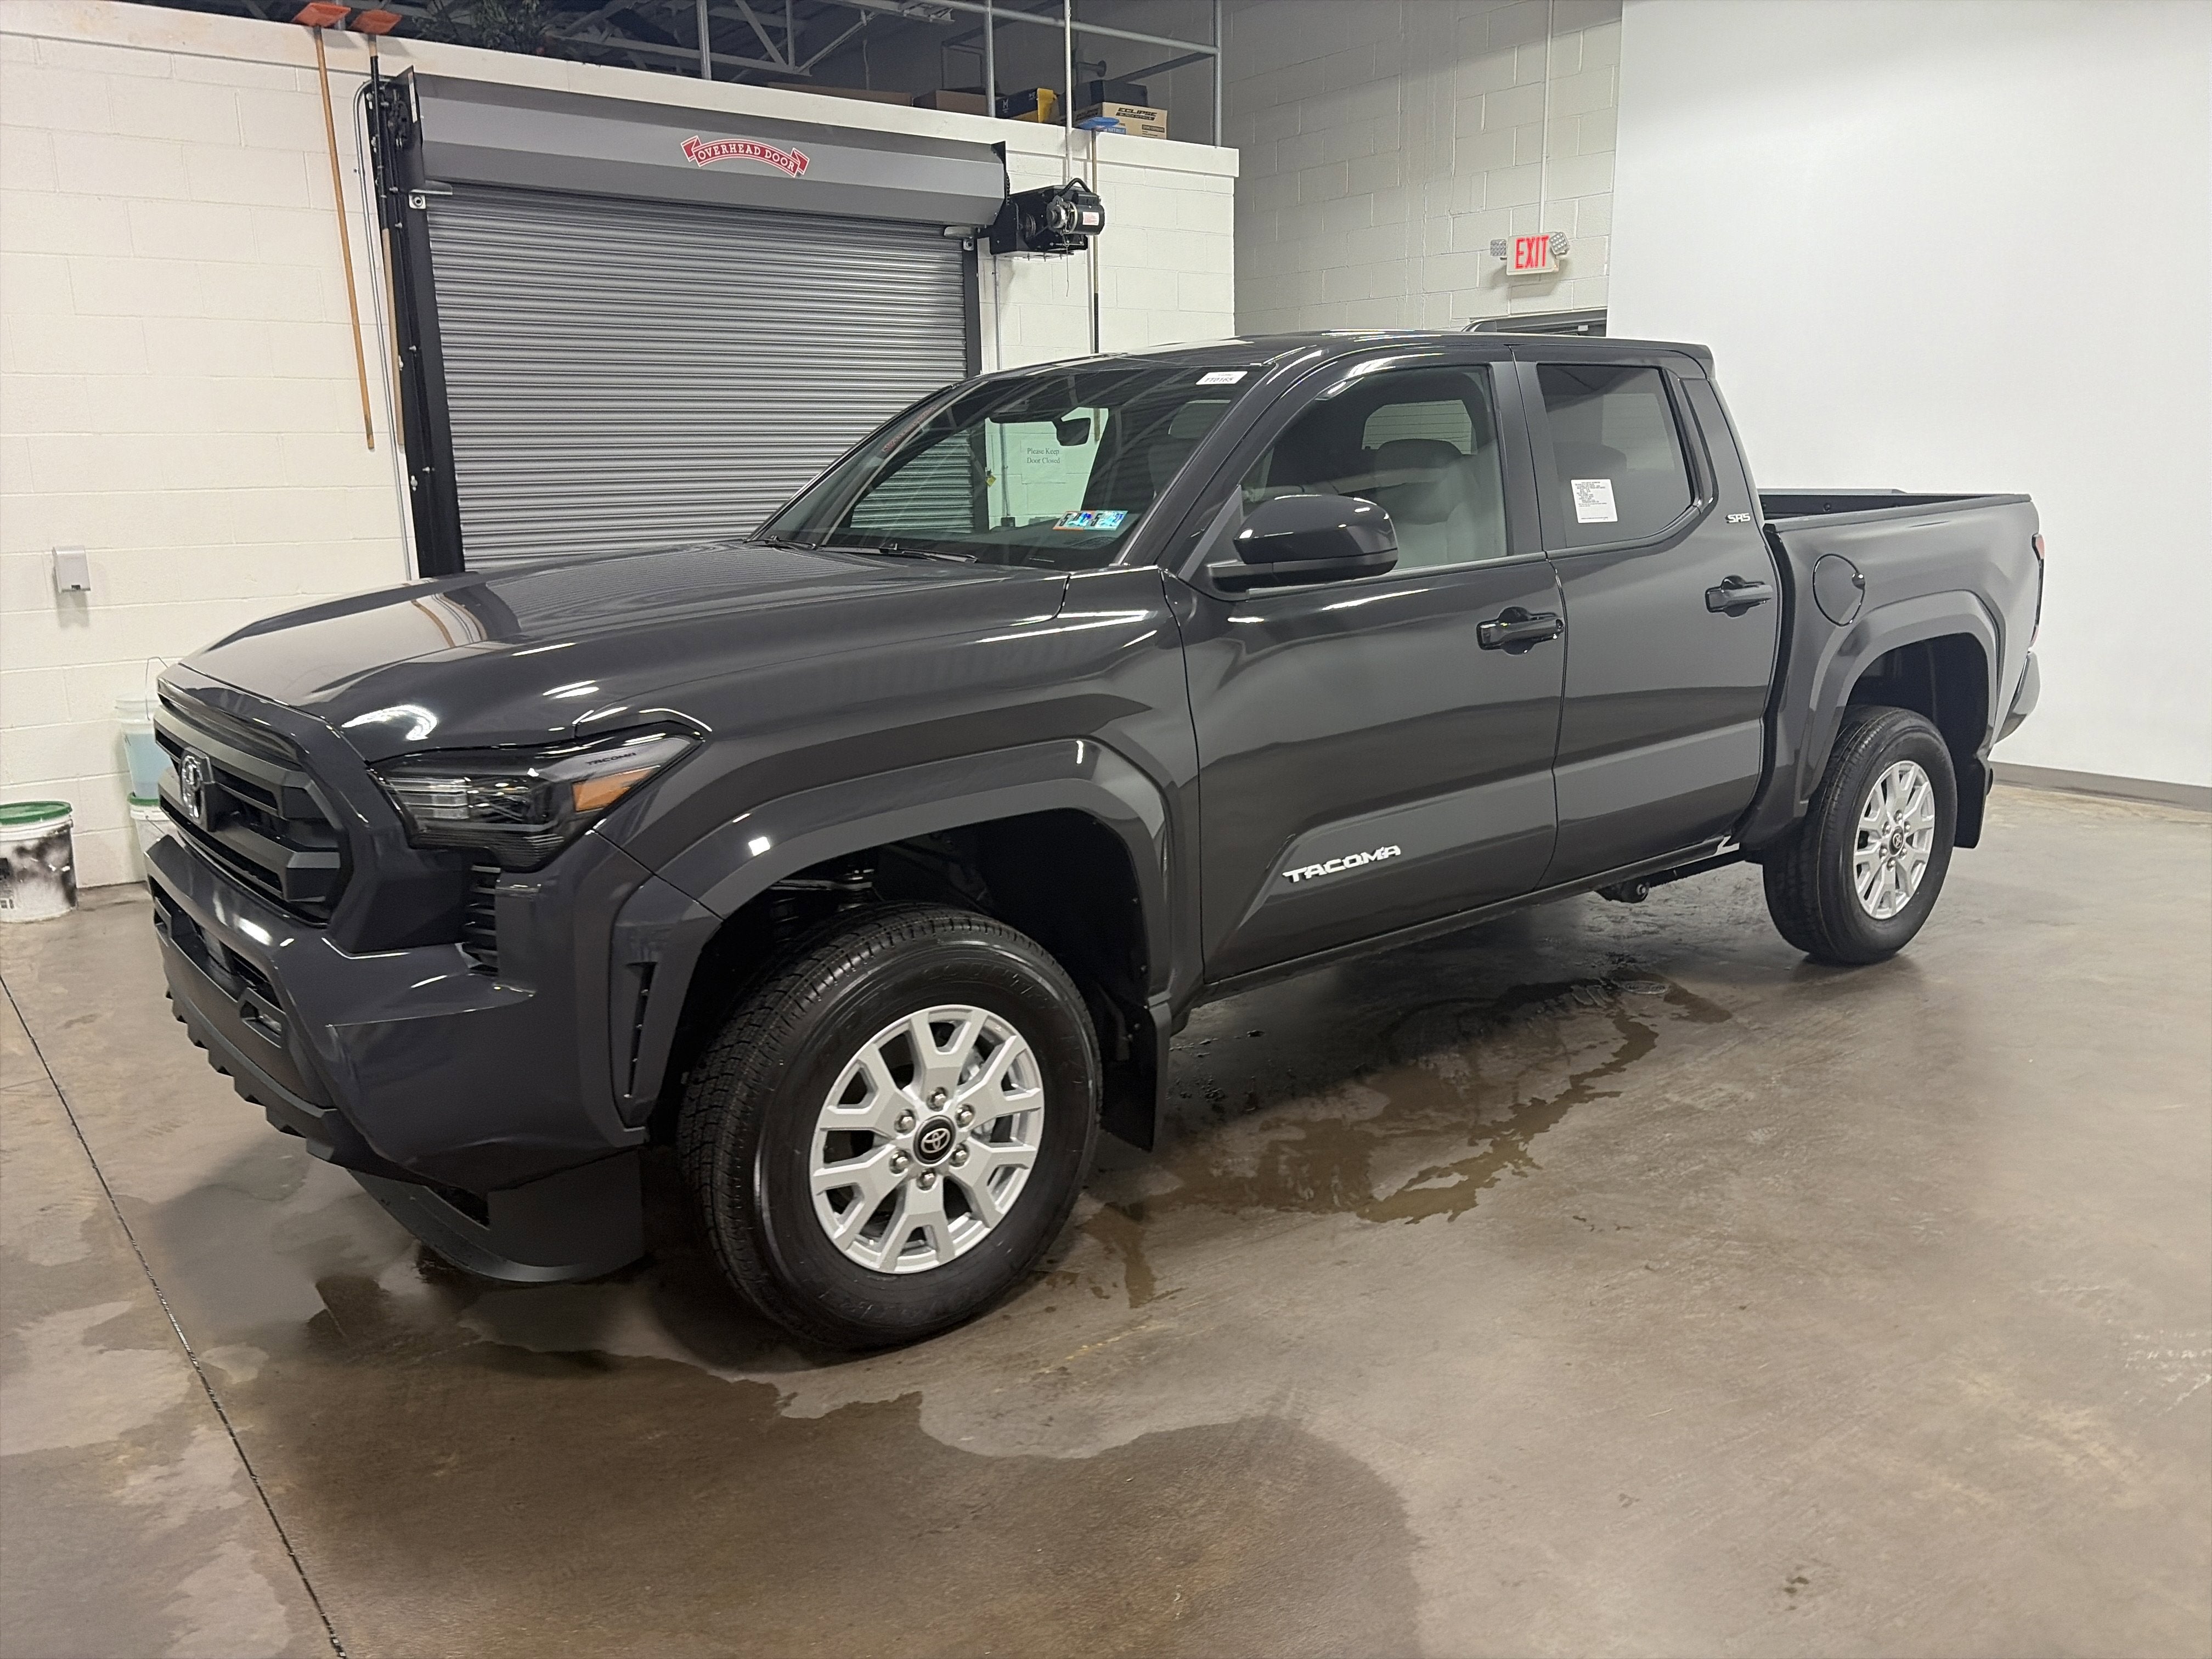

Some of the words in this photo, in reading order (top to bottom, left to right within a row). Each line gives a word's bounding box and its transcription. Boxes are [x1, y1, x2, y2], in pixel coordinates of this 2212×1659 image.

[1118, 108, 1158, 117] ECLIPSE
[698, 144, 761, 160] OVERHEAD
[765, 150, 794, 171] DOOR
[1515, 235, 1549, 269] EXIT
[1045, 448, 1059, 456] Keep
[1727, 512, 1751, 523] SR5
[585, 752, 636, 765] TACOMA
[1282, 845, 1401, 883] TACOMA
